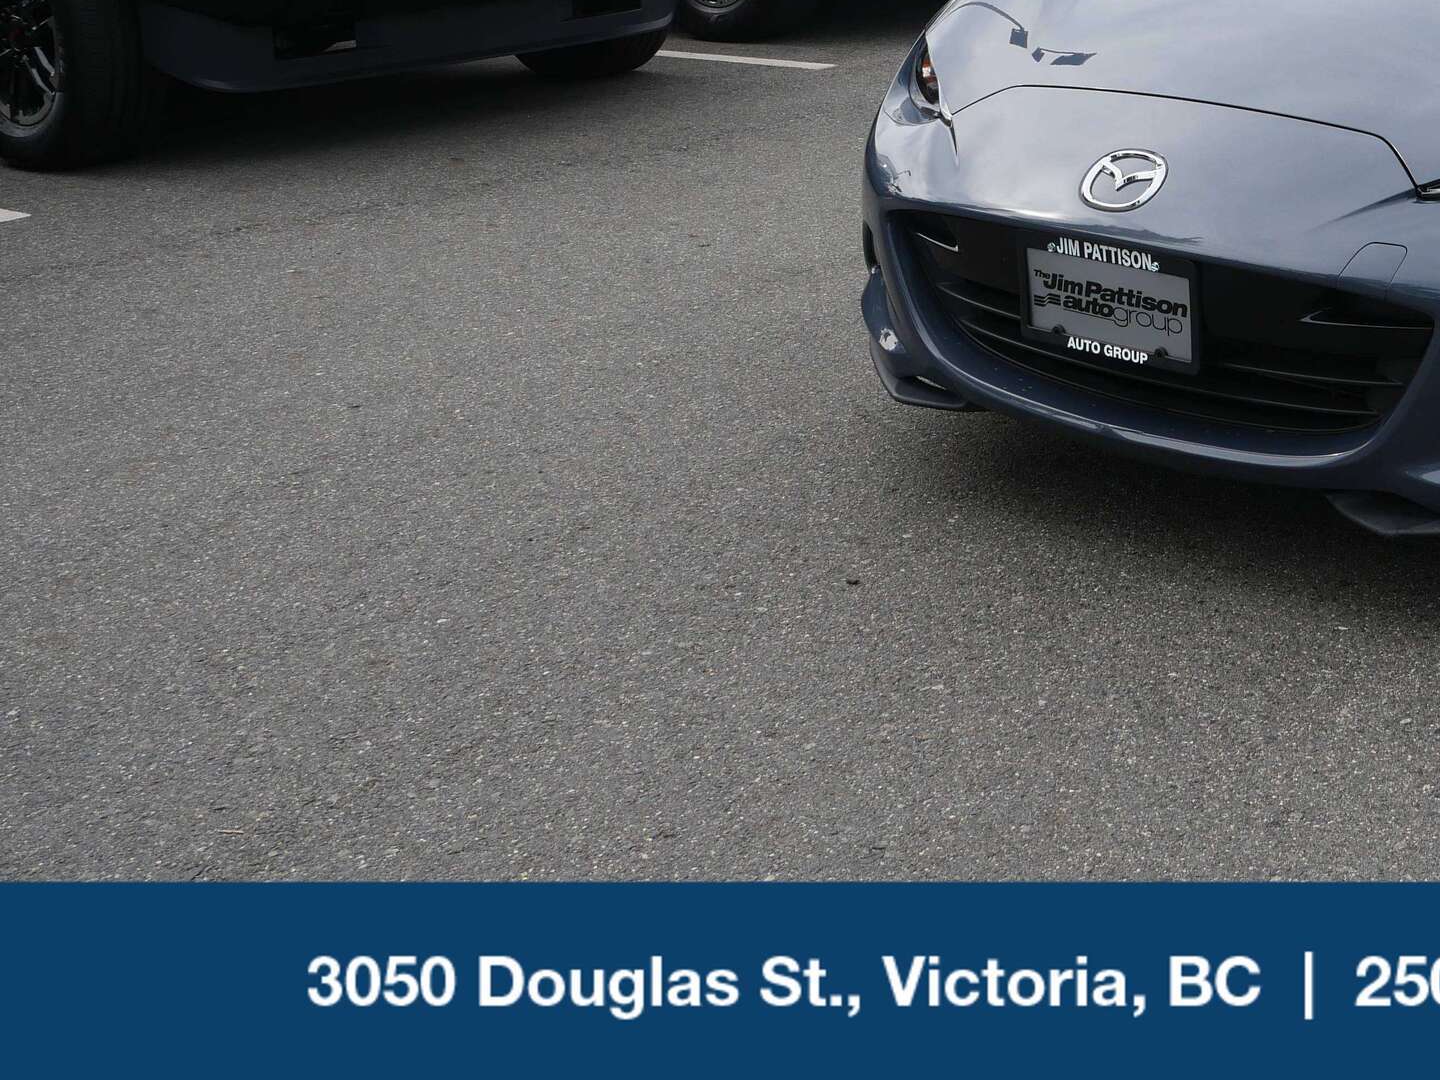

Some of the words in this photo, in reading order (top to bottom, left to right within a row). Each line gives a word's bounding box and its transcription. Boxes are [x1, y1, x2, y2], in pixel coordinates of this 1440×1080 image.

[1056, 237, 1081, 258] JIM
[1083, 241, 1152, 271] PATTISON
[1034, 269, 1050, 280] The
[1067, 336, 1101, 355] AUTO
[1104, 345, 1149, 364] GROUP
